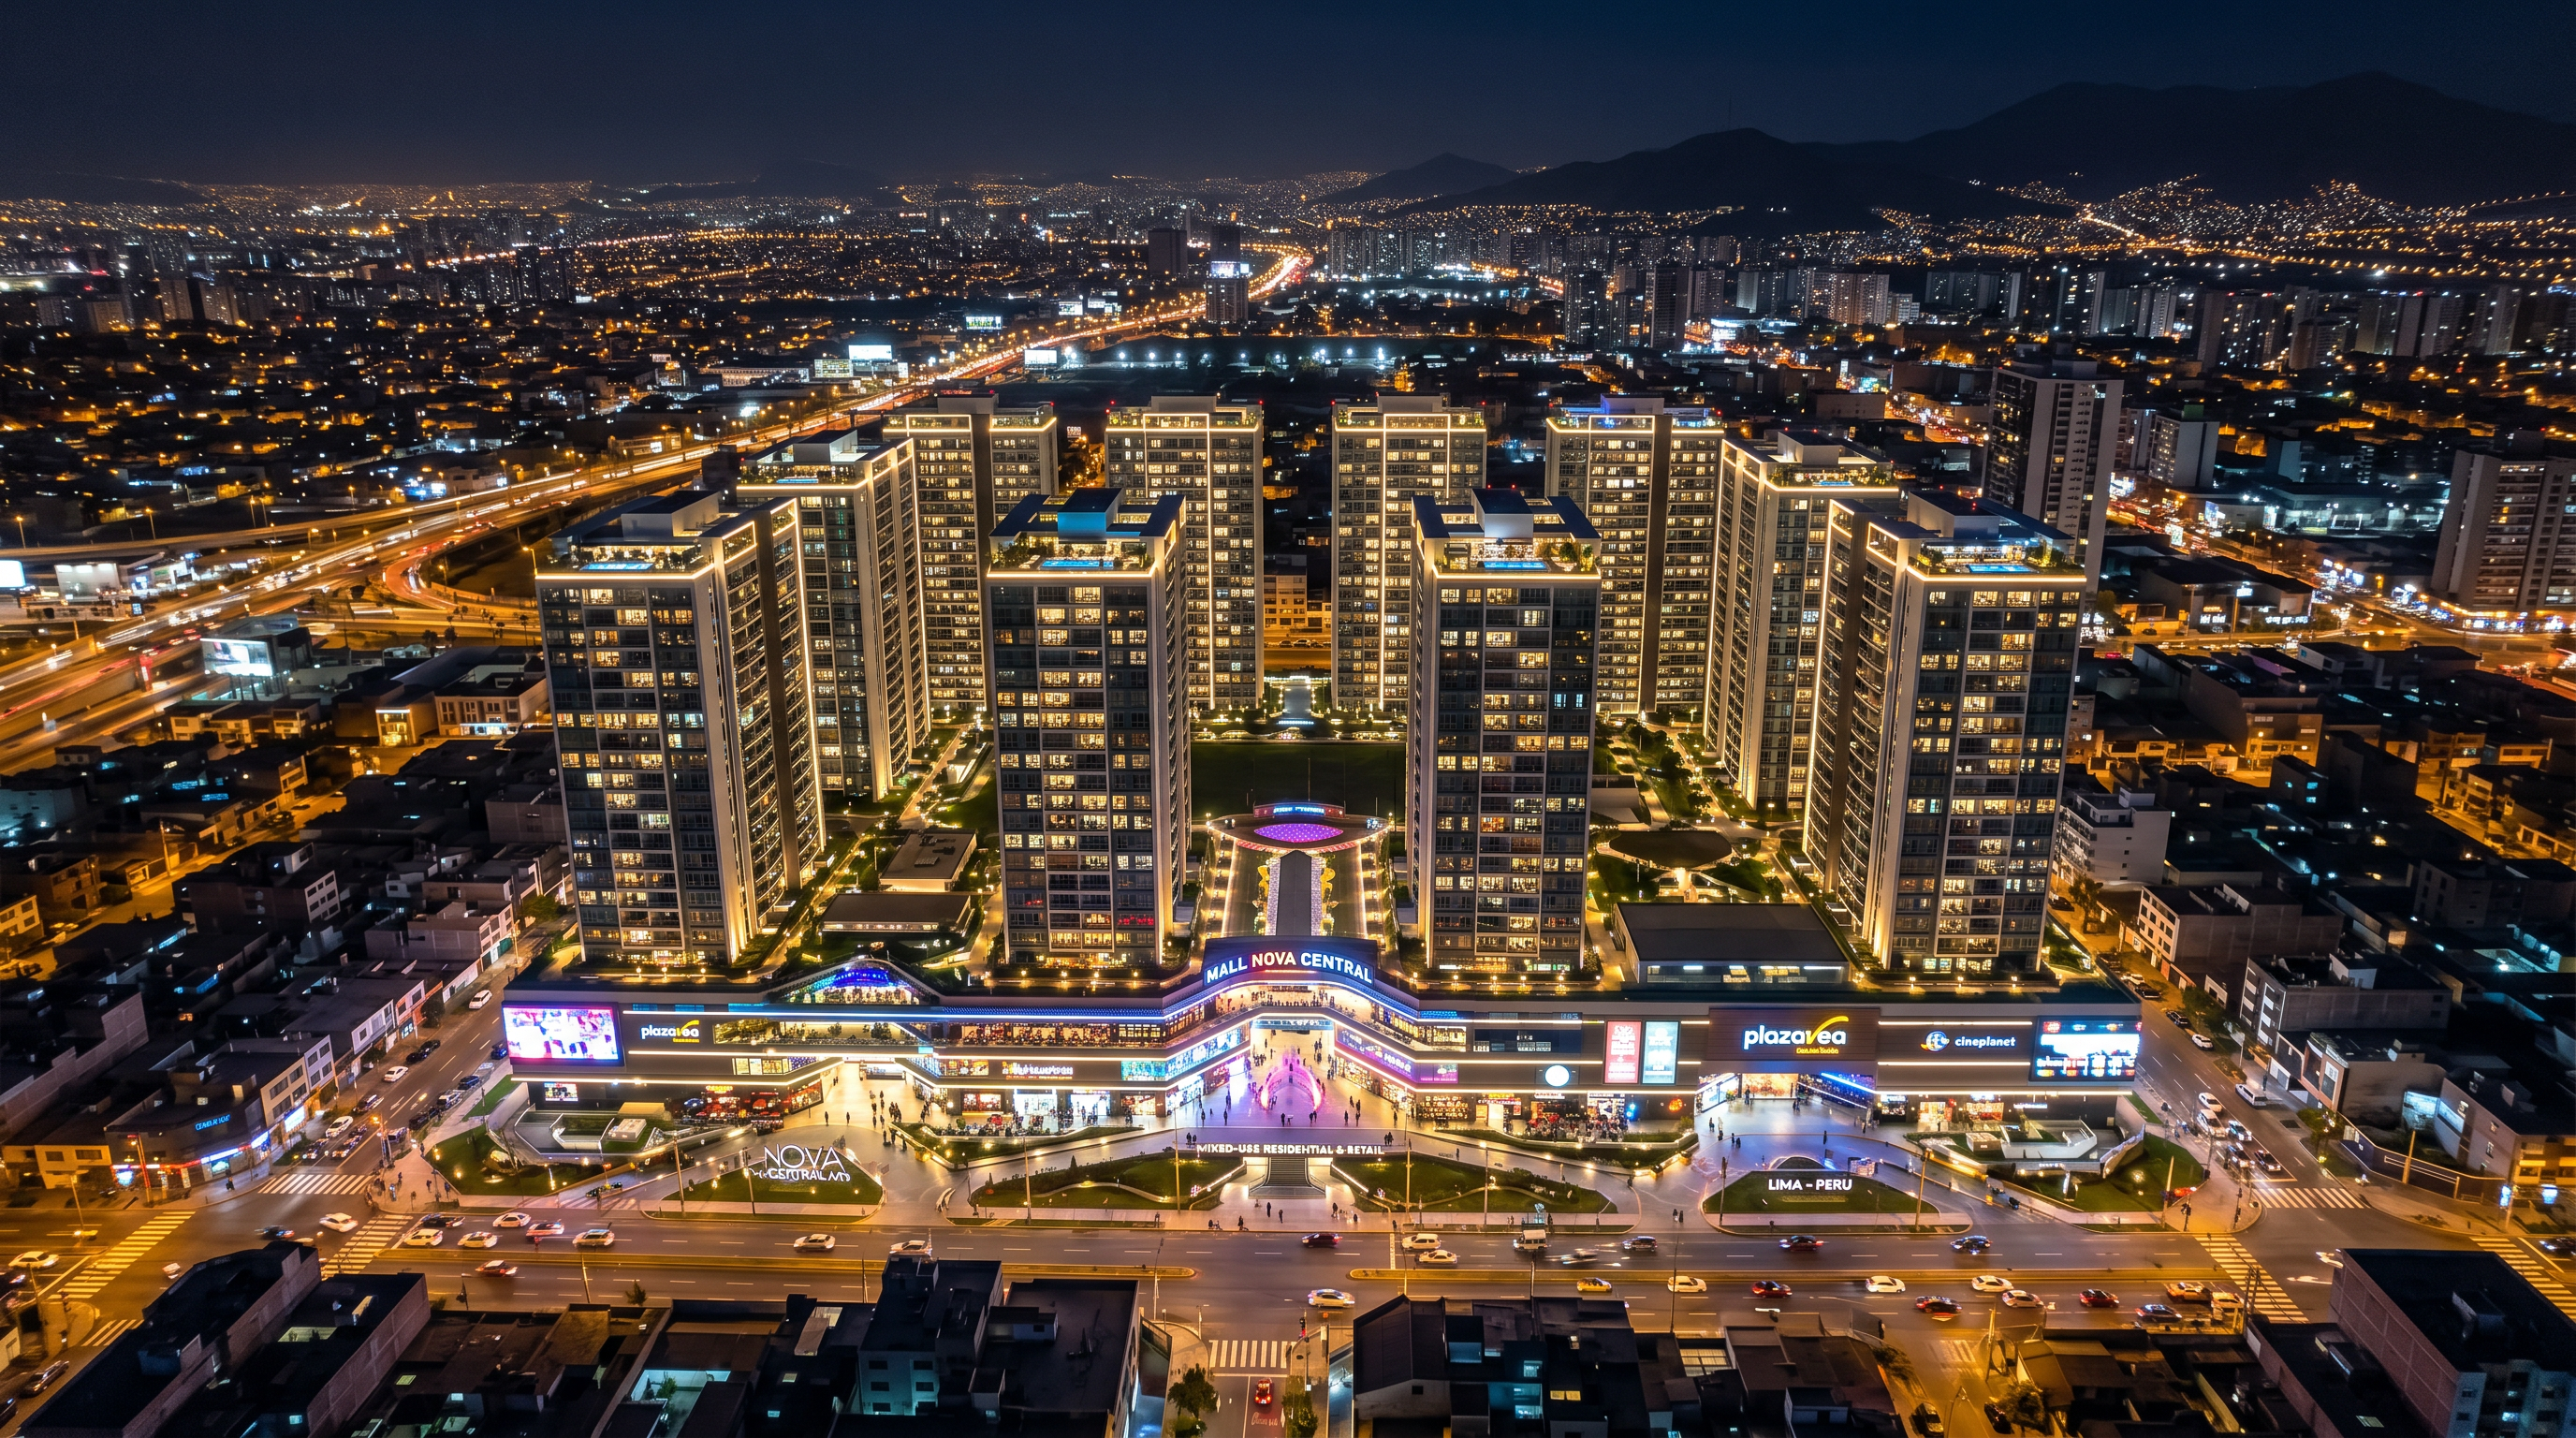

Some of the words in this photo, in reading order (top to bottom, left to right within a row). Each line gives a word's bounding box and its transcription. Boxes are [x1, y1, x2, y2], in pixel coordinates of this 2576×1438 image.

[1207, 957, 1248, 984] MALL
[1251, 951, 1296, 968] NOVA
[1300, 952, 1372, 984] CENTRAL
[1743, 1015, 1850, 1050] plazavea
[1954, 1035, 2016, 1049] cineplanet
[764, 1143, 846, 1172] NOVA
[1196, 1143, 1261, 1153] MIXED-USE
[1264, 1144, 1334, 1154] RESIDENTIAL
[1347, 1145, 1385, 1155] RETAIL
[1768, 1179, 1803, 1191] LIMA
[1816, 1179, 1852, 1191] PERU
